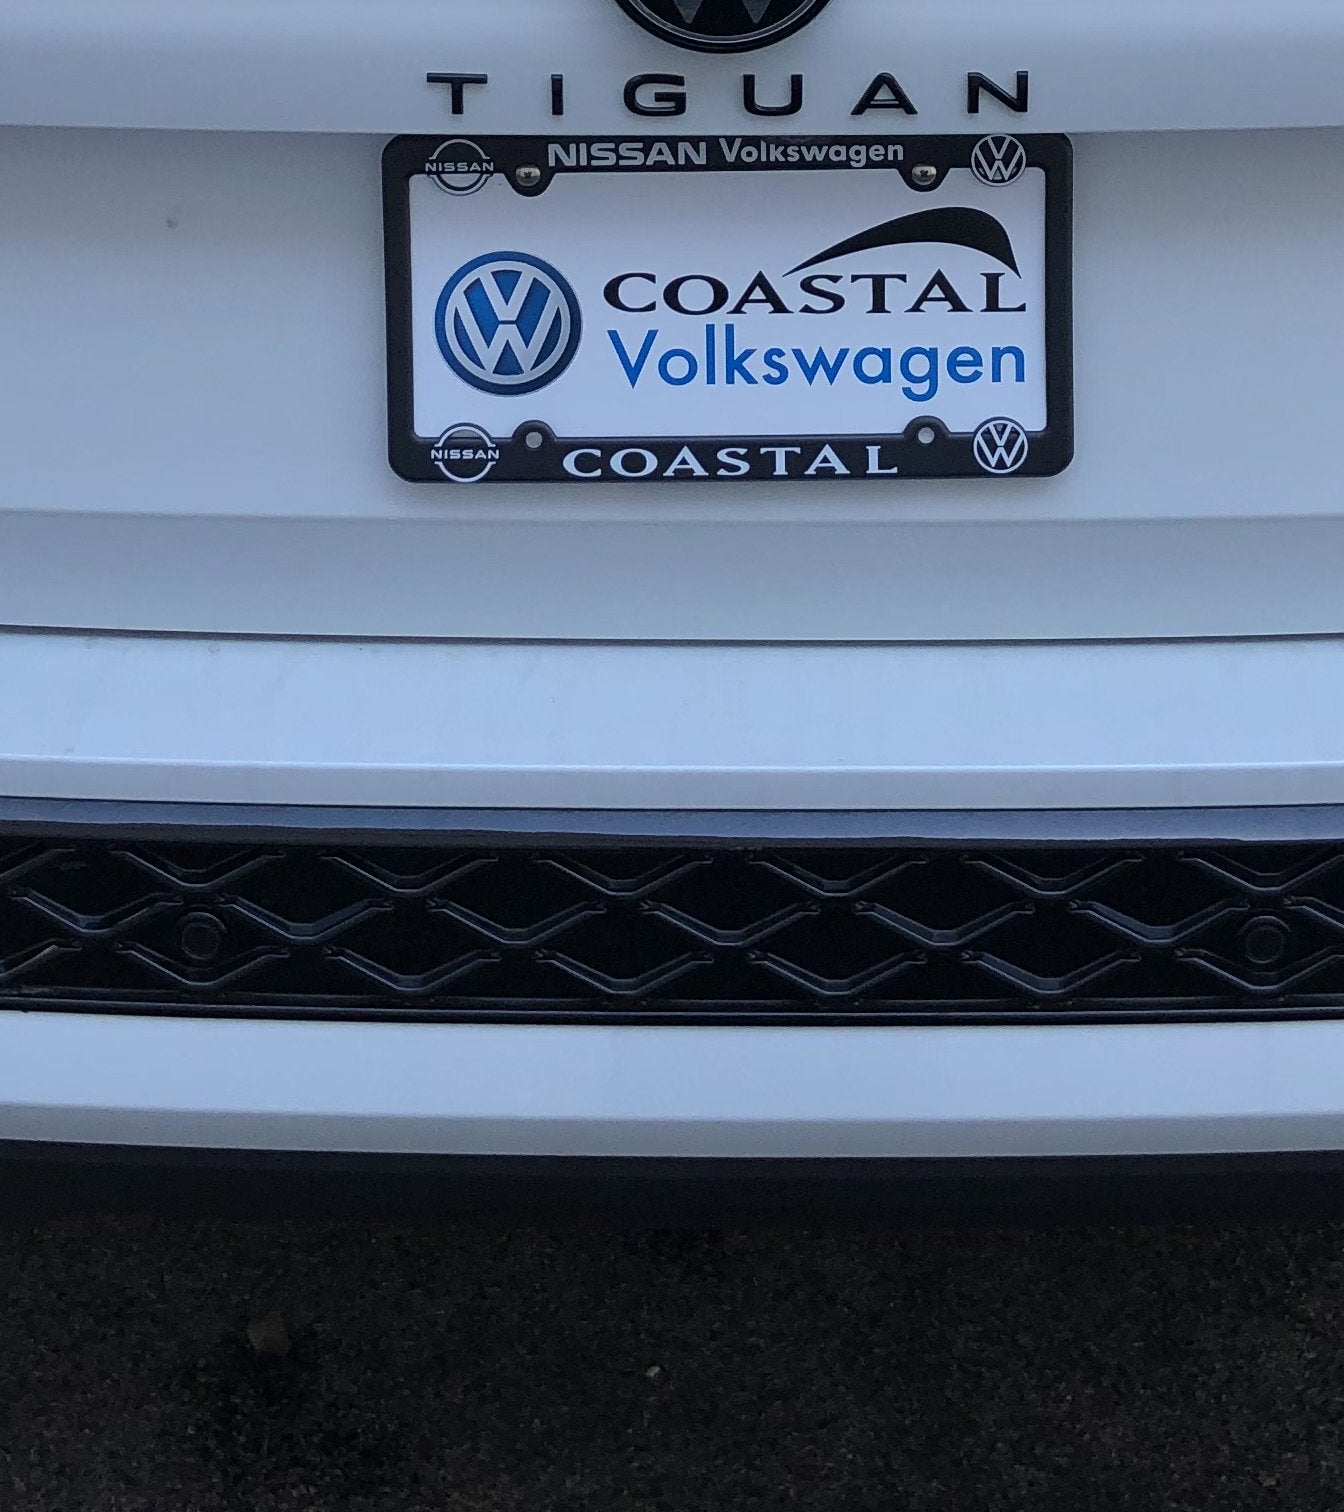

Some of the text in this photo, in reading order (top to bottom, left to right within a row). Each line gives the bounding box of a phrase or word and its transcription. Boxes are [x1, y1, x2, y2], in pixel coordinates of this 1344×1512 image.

[426, 71, 1029, 116] TIGUAN
[425, 160, 494, 173] NISSAN
[548, 137, 905, 168] NISSAN Volkswagen
[602, 269, 1027, 316] COASTAL
[606, 324, 1026, 403] Volkswagen
[430, 446, 500, 462] NISSAN
[562, 444, 898, 478] COASTAL
